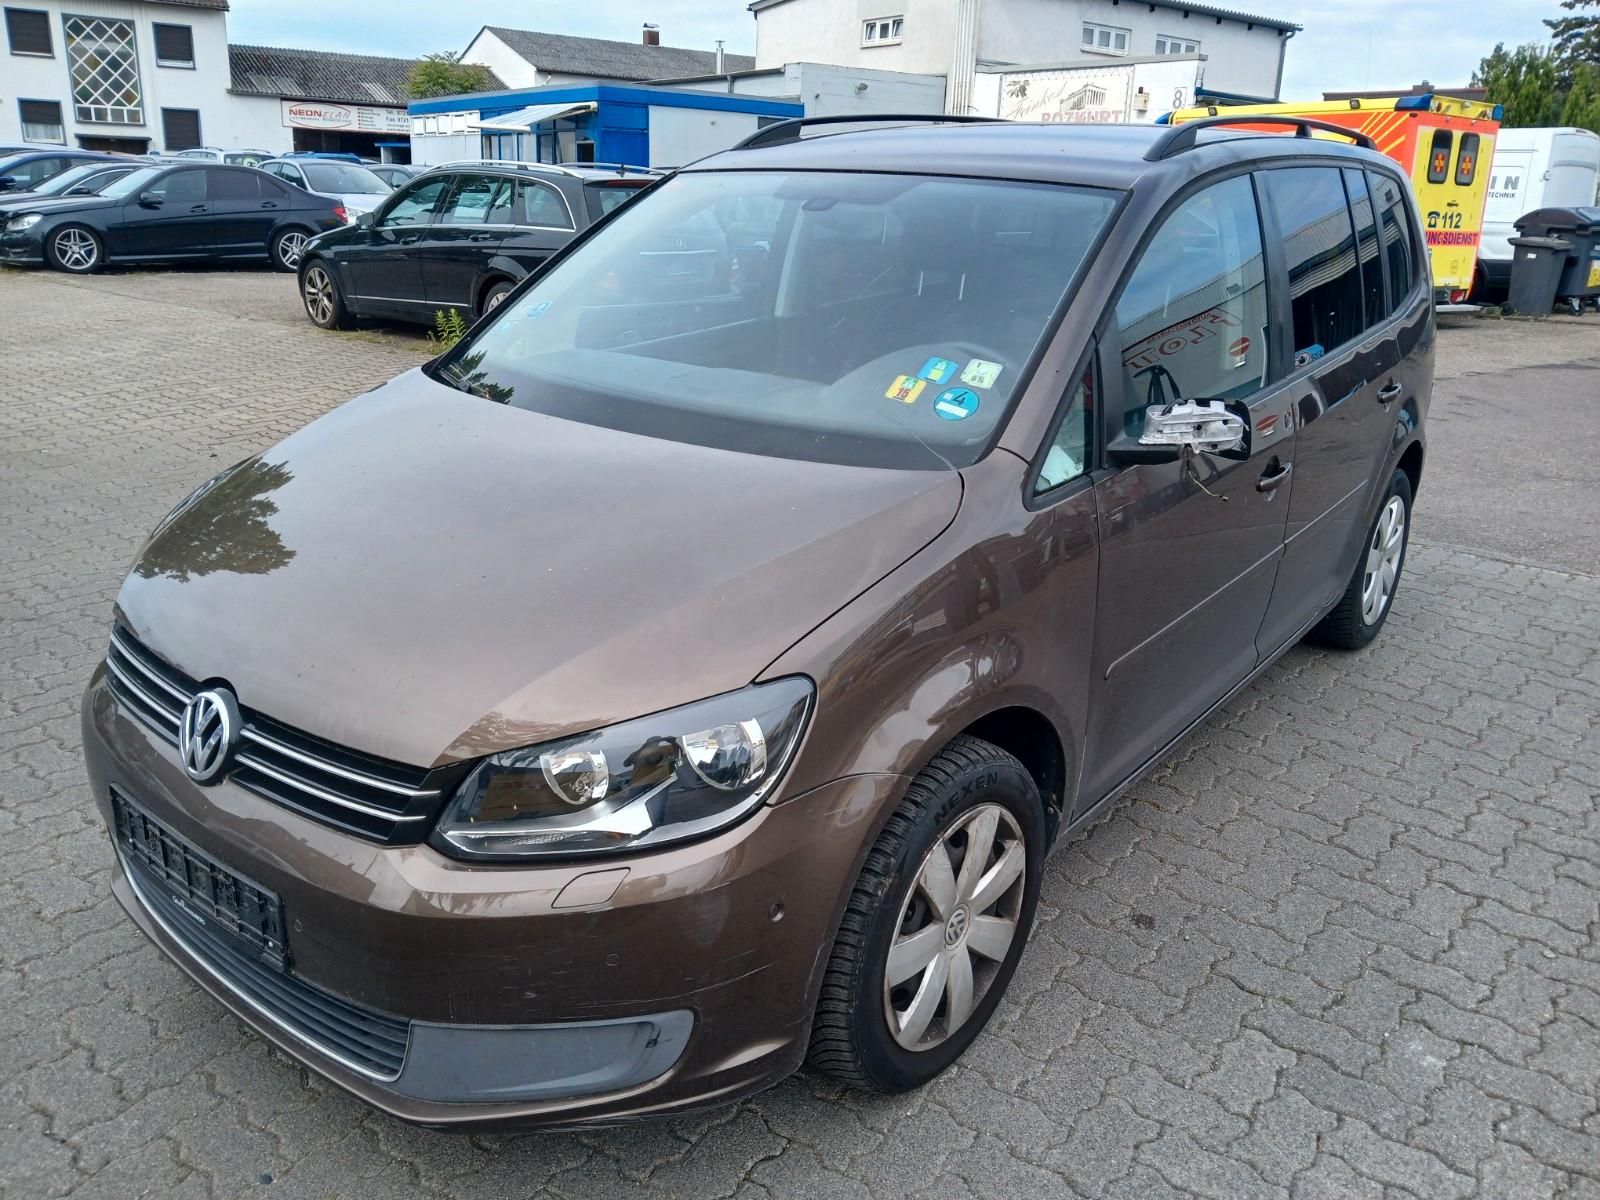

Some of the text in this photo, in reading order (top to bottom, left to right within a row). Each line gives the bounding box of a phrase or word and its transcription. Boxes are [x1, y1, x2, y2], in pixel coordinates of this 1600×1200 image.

[1172, 89, 1183, 109] 8
[289, 109, 322, 117] NEON
[1441, 212, 1462, 229] 112
[934, 771, 999, 825] NEXEN
